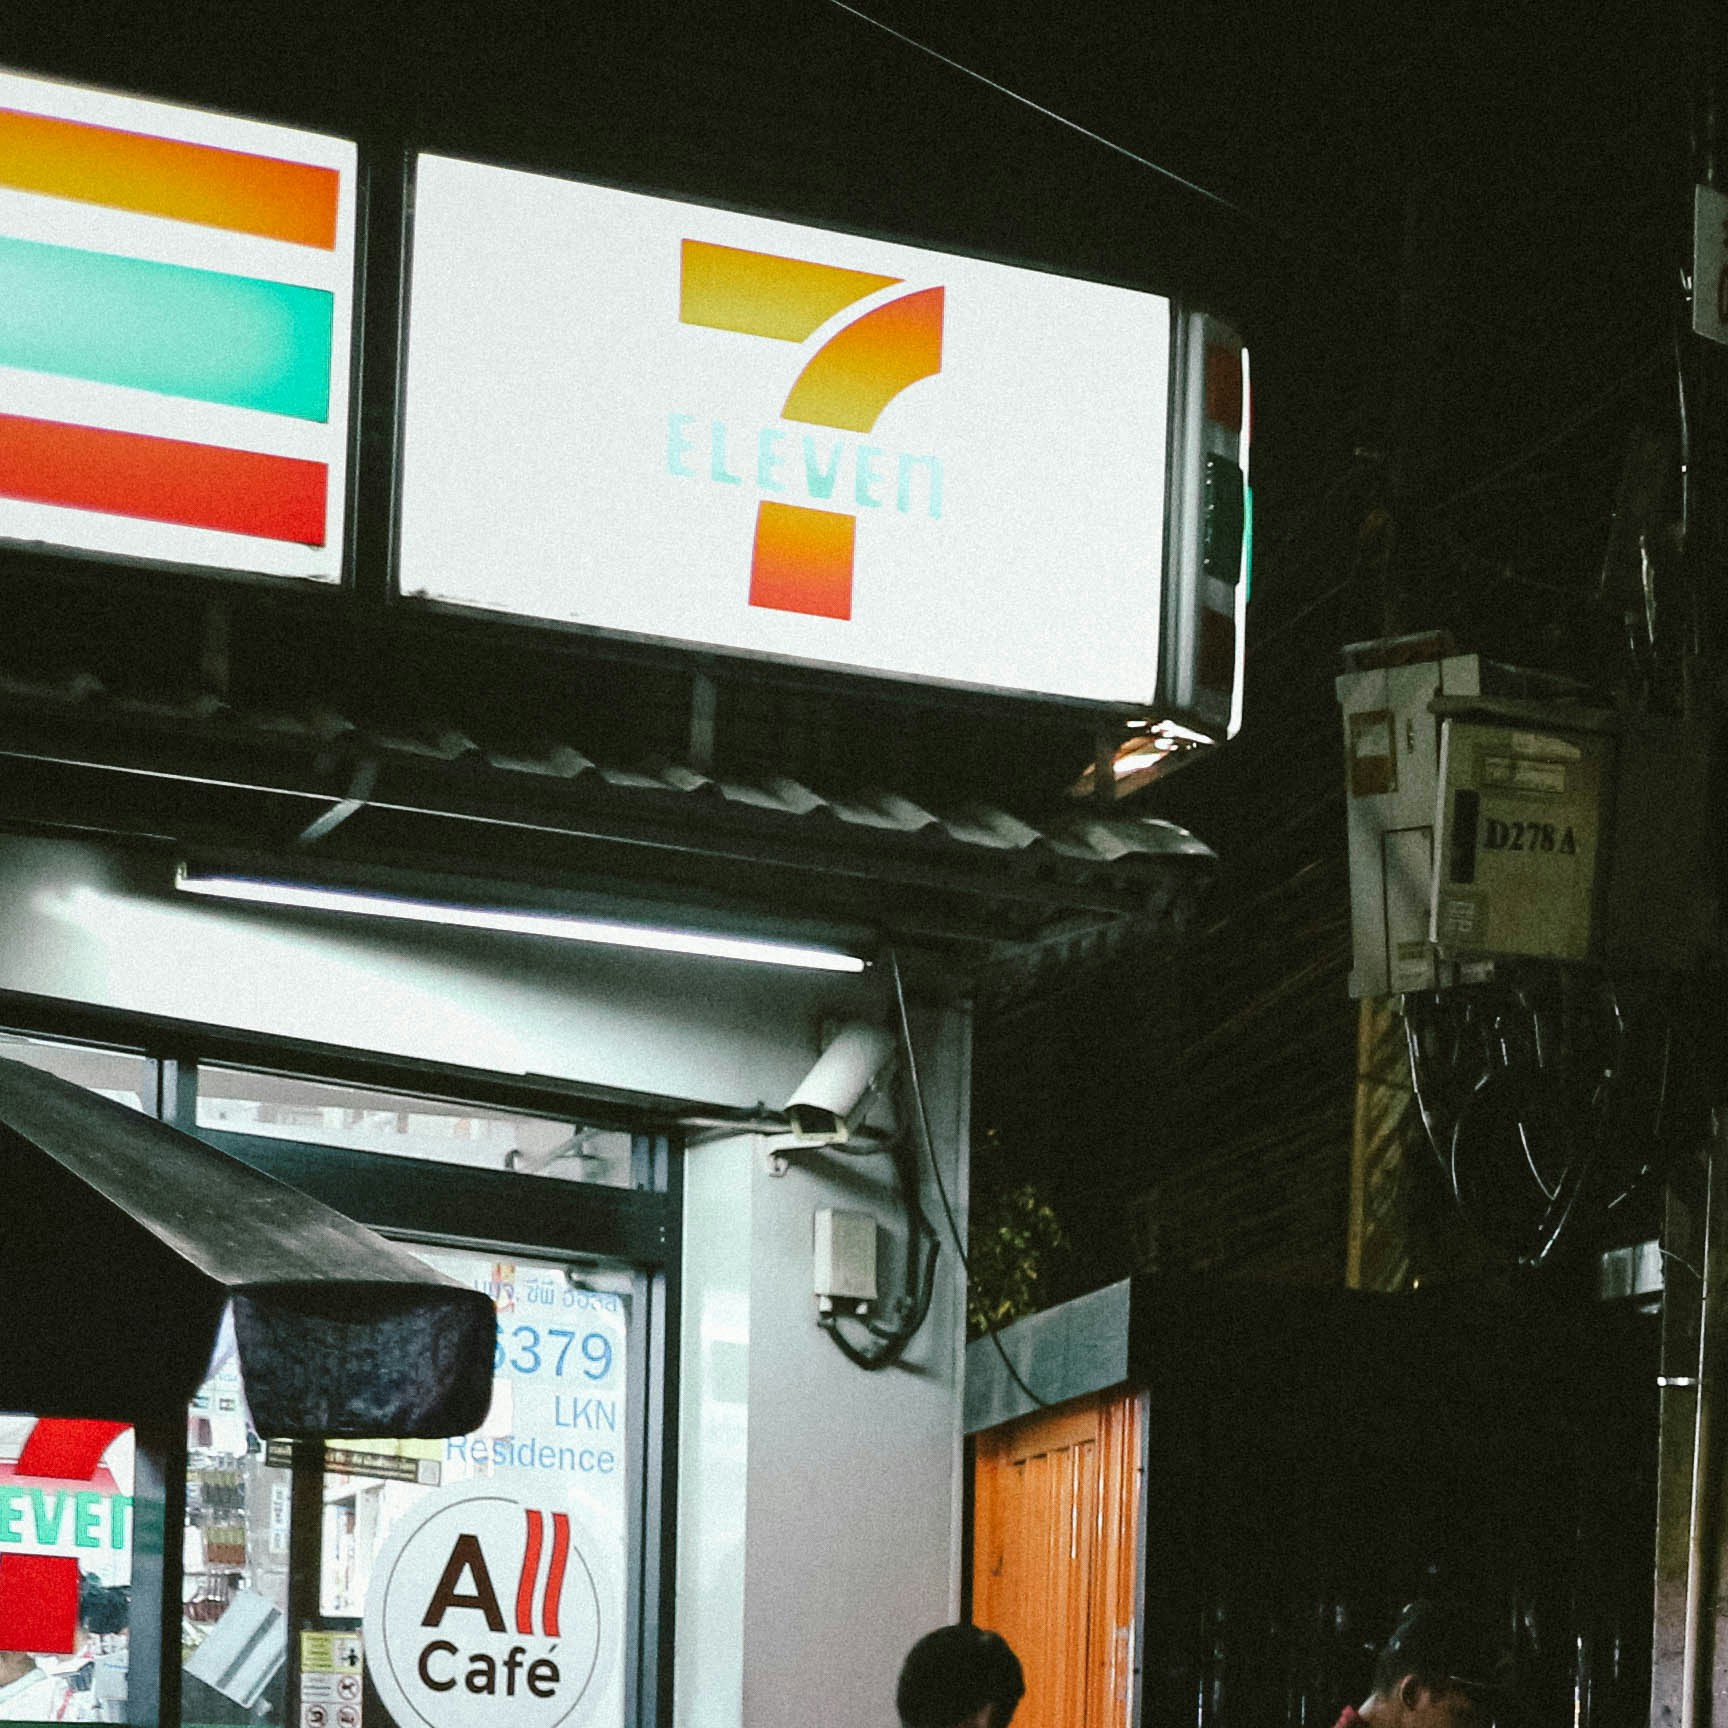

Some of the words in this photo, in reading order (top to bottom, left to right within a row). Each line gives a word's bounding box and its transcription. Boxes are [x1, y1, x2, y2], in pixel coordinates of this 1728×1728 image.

[679, 238, 946, 622] 7
[555, 1395, 616, 1432] LKN
[446, 1434, 616, 1475] Residence
[421, 1508, 570, 1639] All
[418, 1639, 561, 1699] Café
